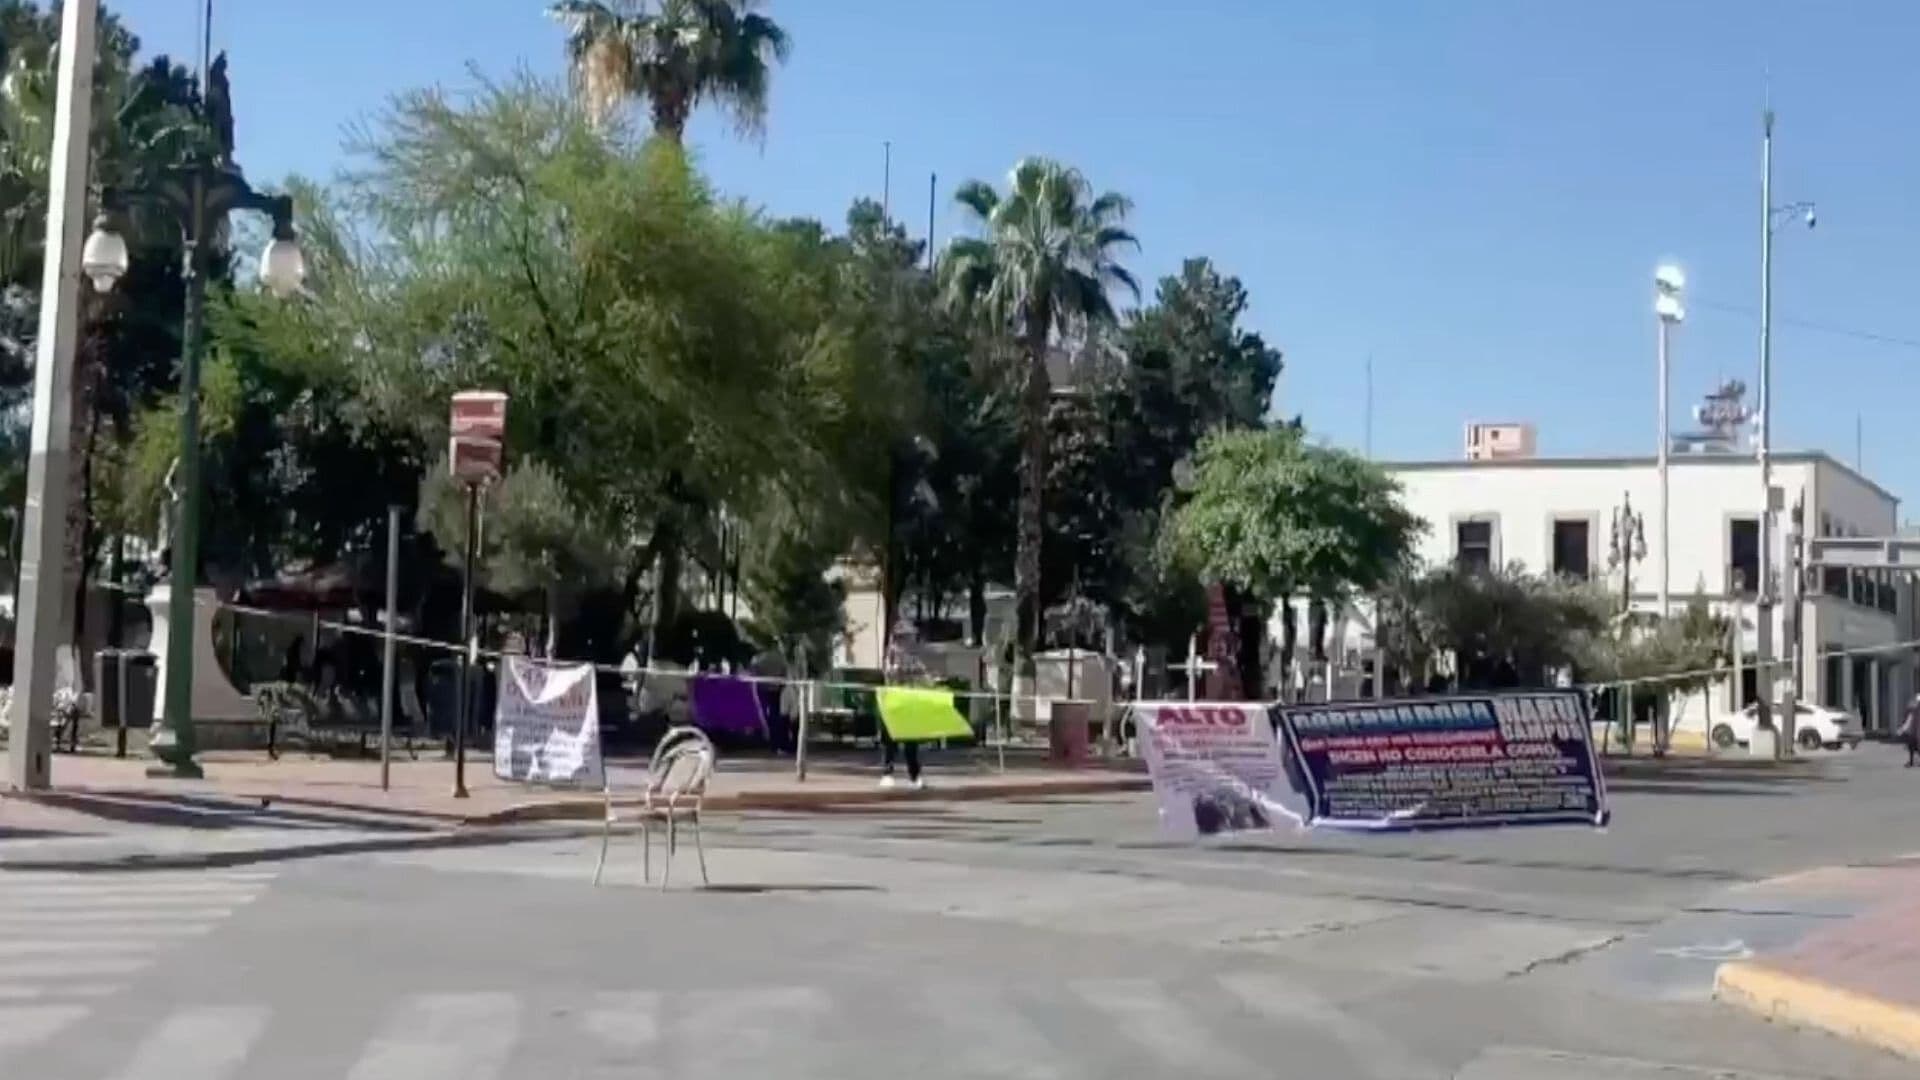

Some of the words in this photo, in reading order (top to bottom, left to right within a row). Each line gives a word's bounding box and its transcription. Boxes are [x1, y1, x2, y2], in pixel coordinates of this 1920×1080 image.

[1156, 706, 1247, 727] ALTO
[1377, 748, 1403, 762] NO
[1404, 743, 1505, 761] CONOCERLA
